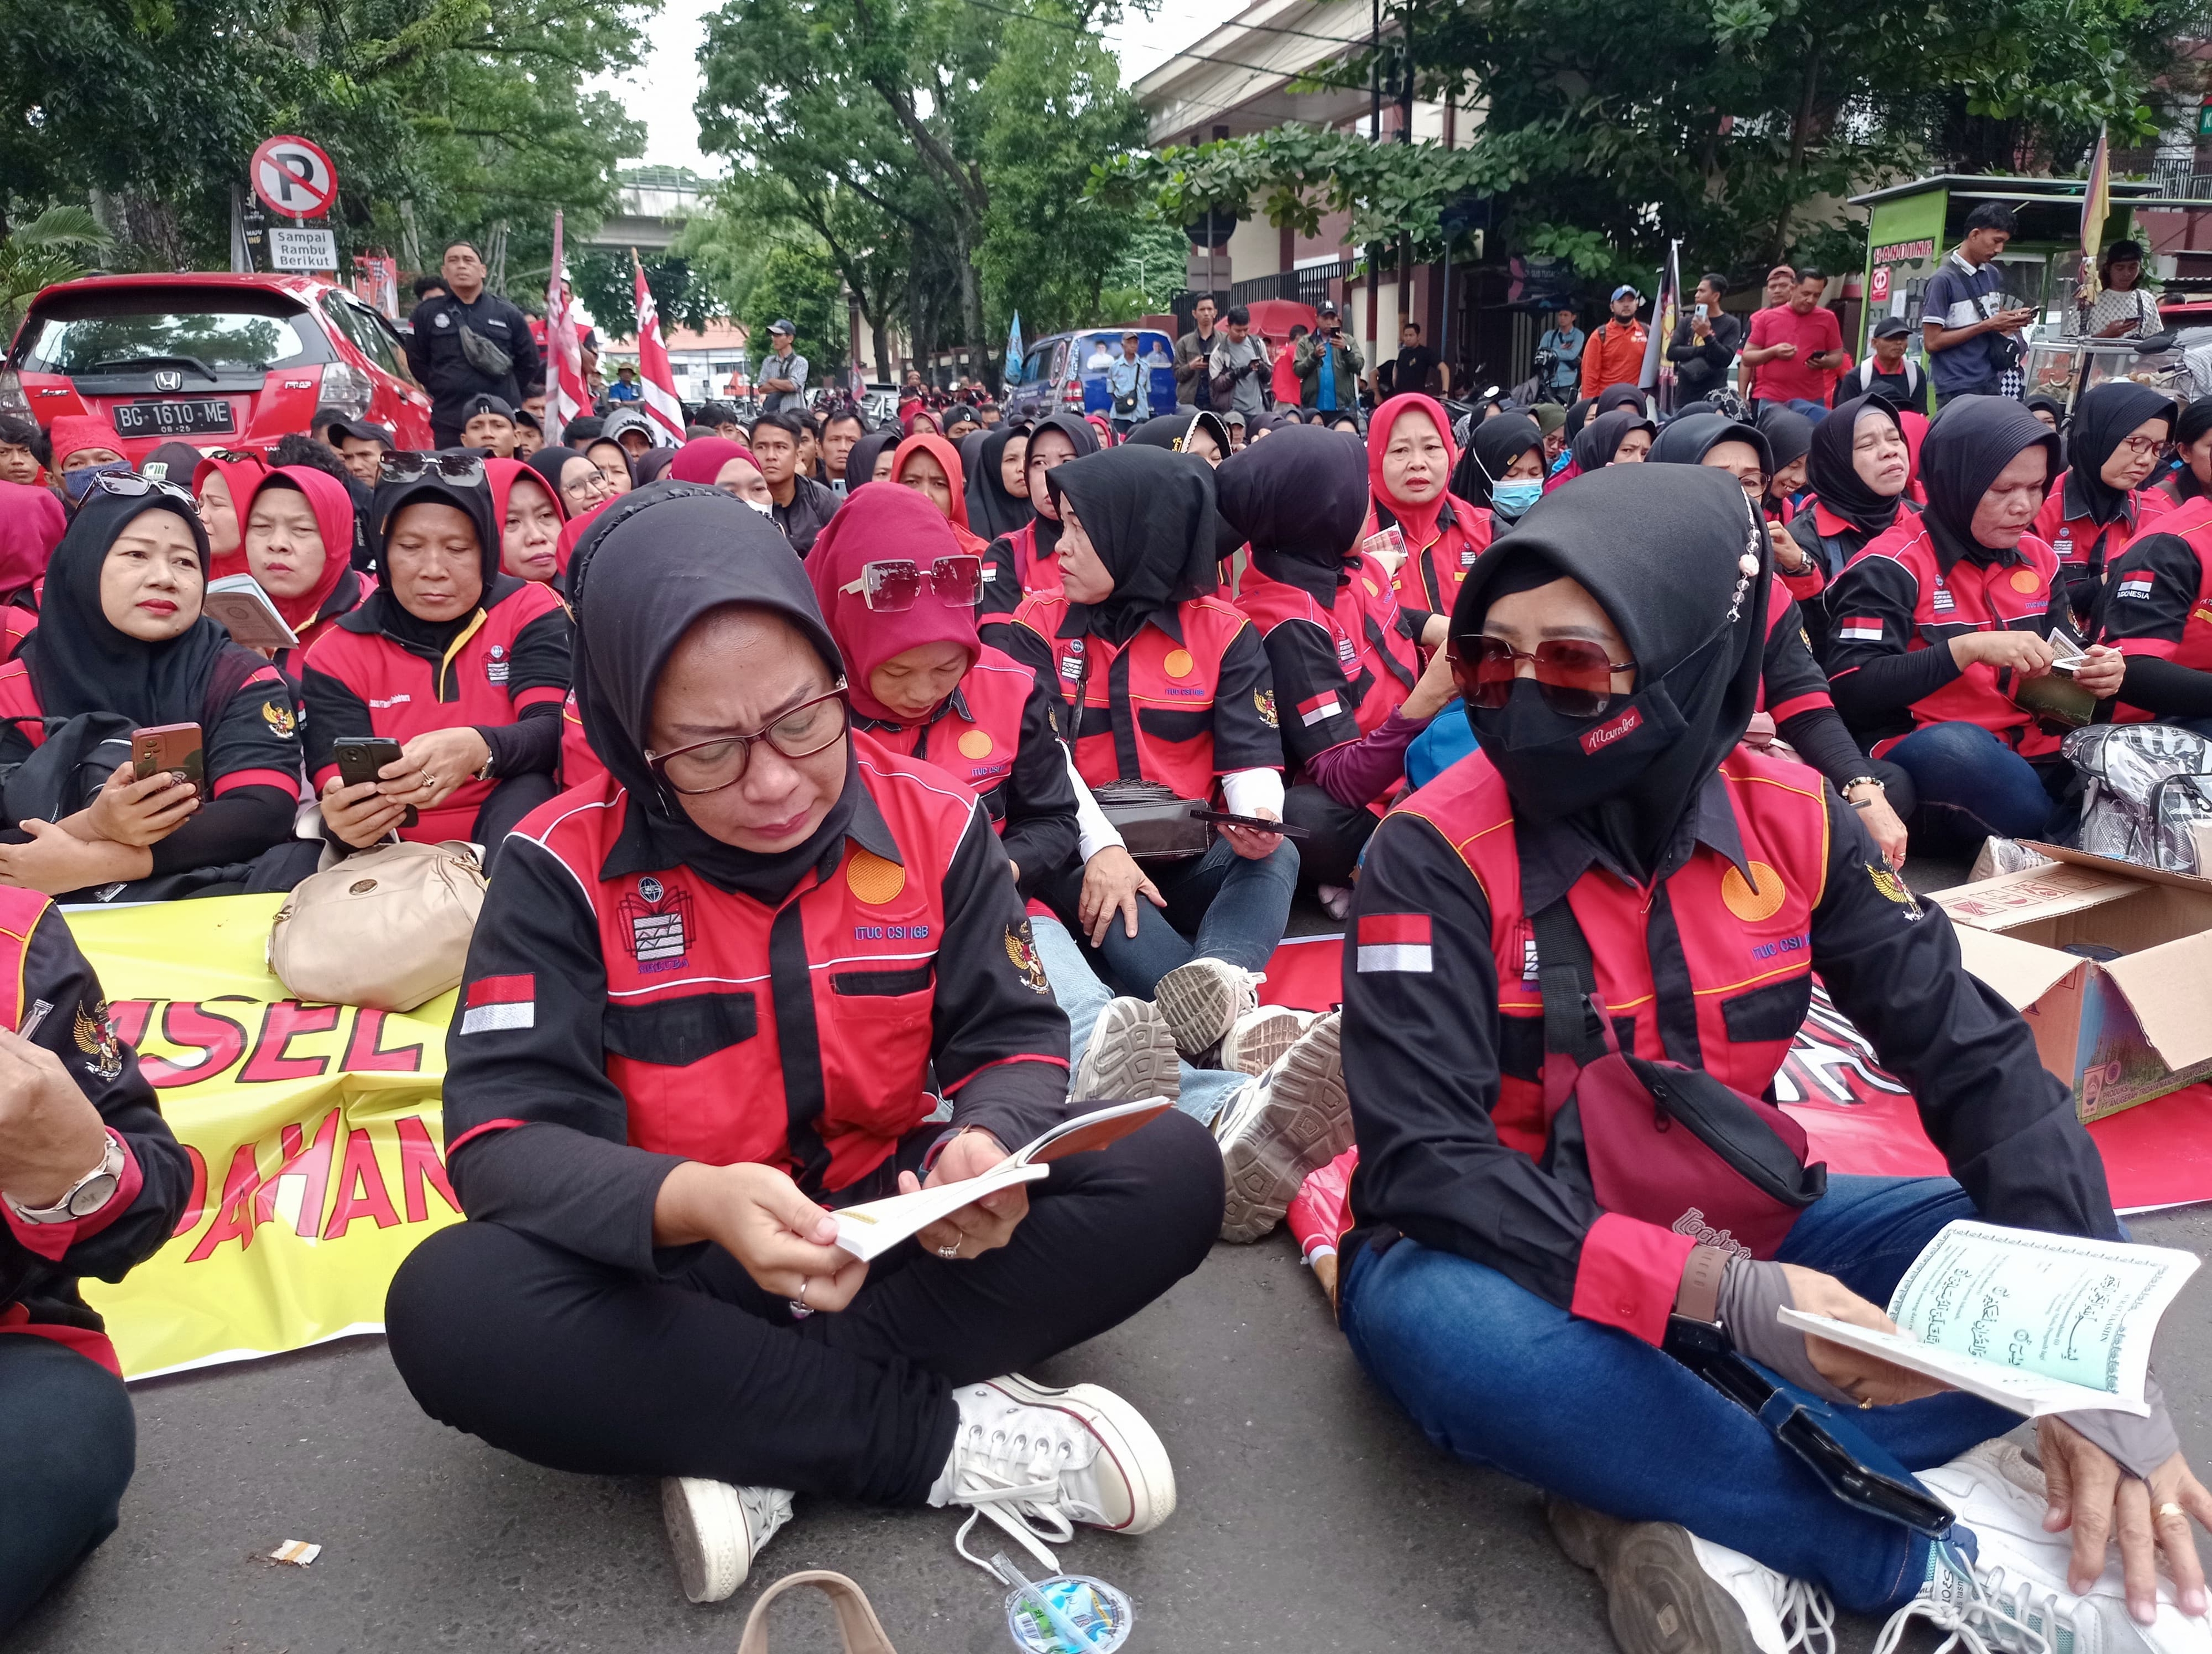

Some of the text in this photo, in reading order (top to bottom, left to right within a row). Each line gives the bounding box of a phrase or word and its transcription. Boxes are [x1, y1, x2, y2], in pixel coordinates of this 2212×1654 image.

[278, 232, 326, 244] Sampai
[281, 245, 325, 255] Rambu
[1873, 240, 1933, 265] BANDUNG
[280, 255, 330, 267] Berikut
[119, 401, 228, 428] BG 1610 ME
[1588, 715, 1635, 748] Mambo
[971, 767, 987, 777] ITUC
[854, 924, 929, 941] ITUC CSI IGB
[1751, 942, 1777, 962] ITUC
[1779, 936, 1803, 952] CSI
